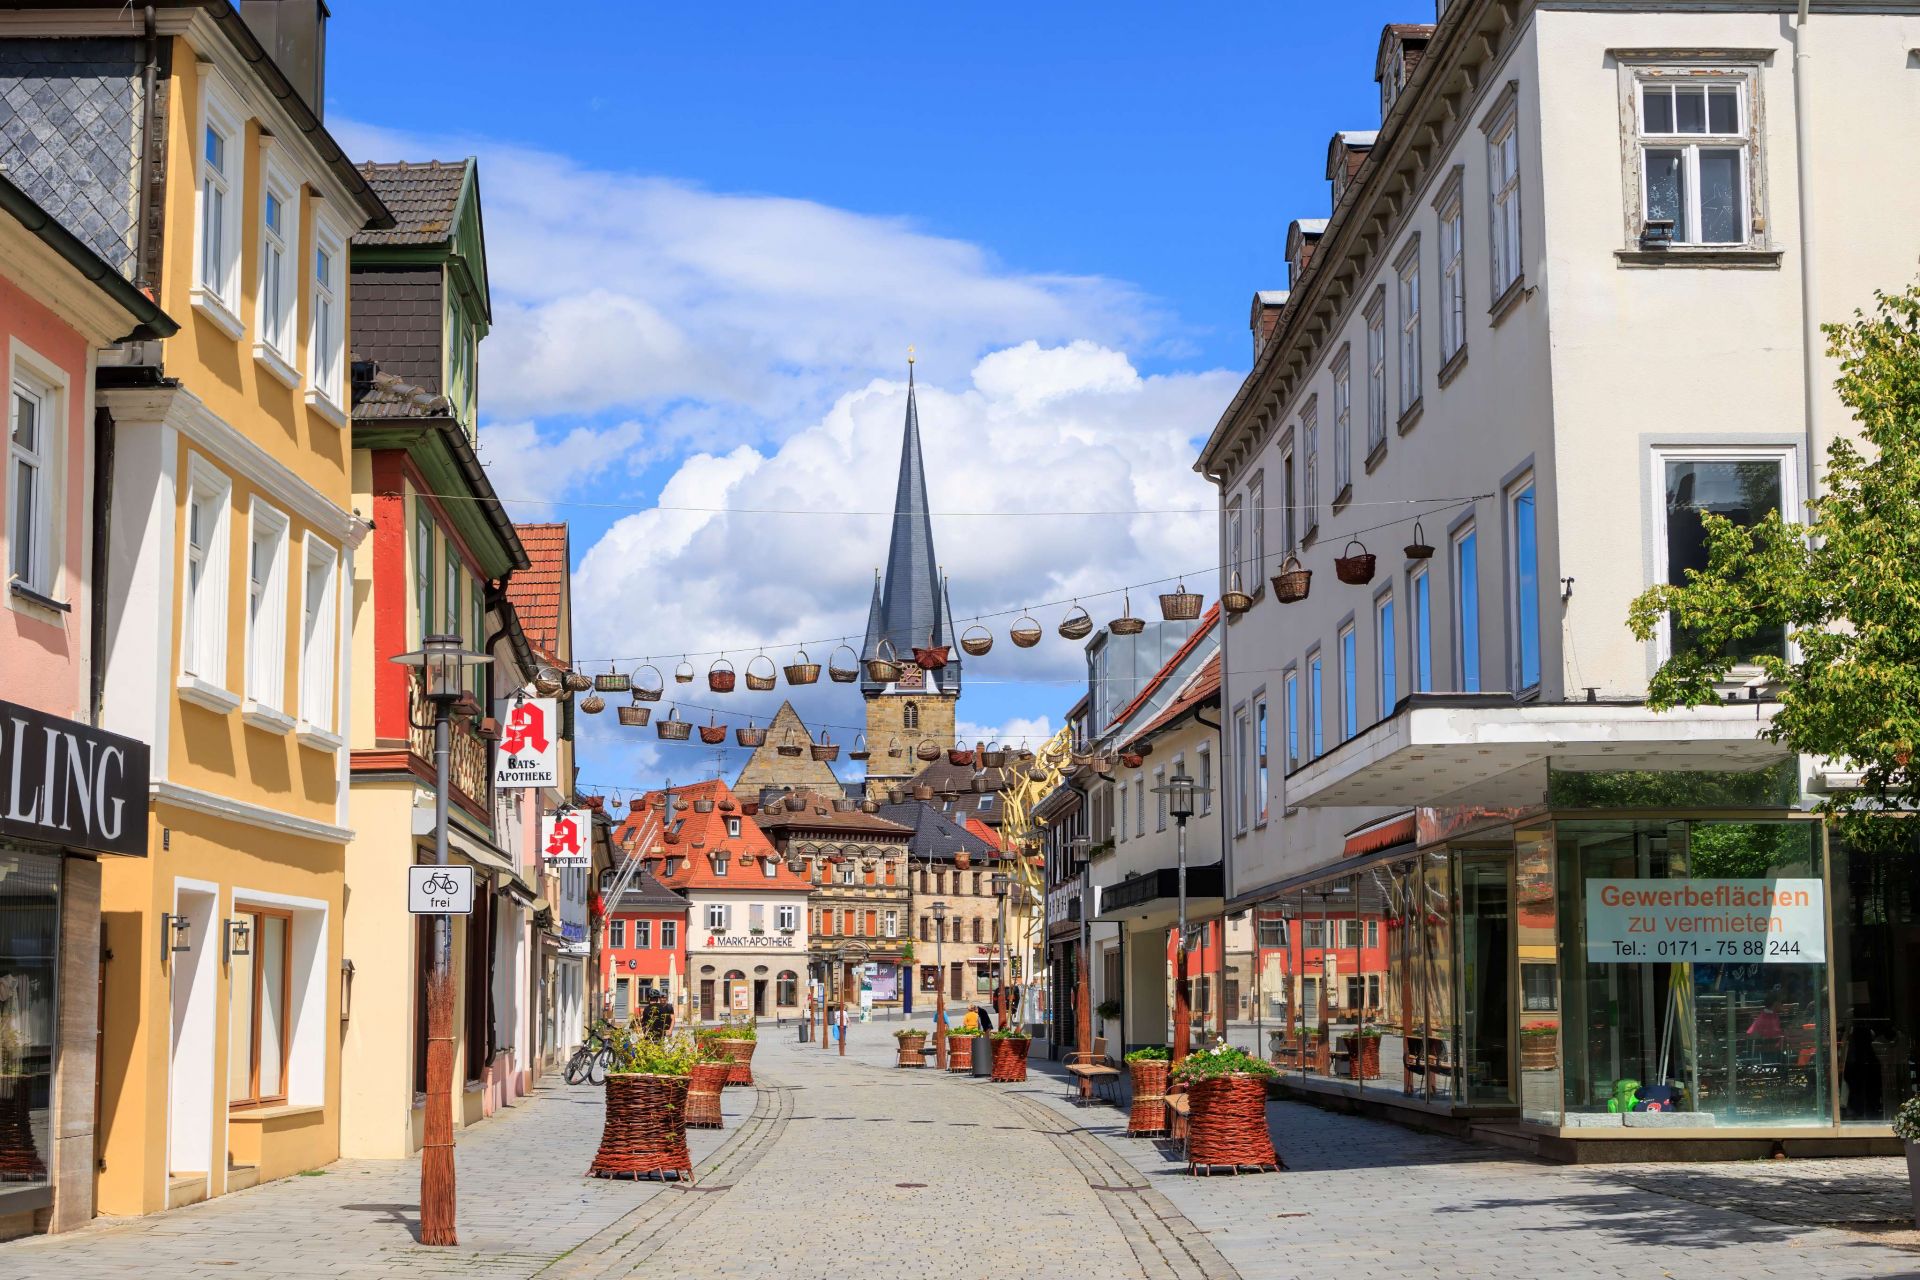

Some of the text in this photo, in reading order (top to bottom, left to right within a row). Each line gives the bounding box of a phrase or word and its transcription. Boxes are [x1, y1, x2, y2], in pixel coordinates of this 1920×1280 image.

[0, 717, 126, 840] LING
[497, 770, 552, 782] APOTHEKE
[430, 897, 450, 908] frei
[1600, 885, 1809, 907] Gewerbeflächen
[1627, 912, 1783, 933] zu vermieten
[1612, 940, 1646, 956] Tel.:
[1657, 940, 1698, 956] 0171
[1716, 940, 1737, 956] 75
[1743, 940, 1764, 956] 88
[1769, 940, 1801, 956] 244
